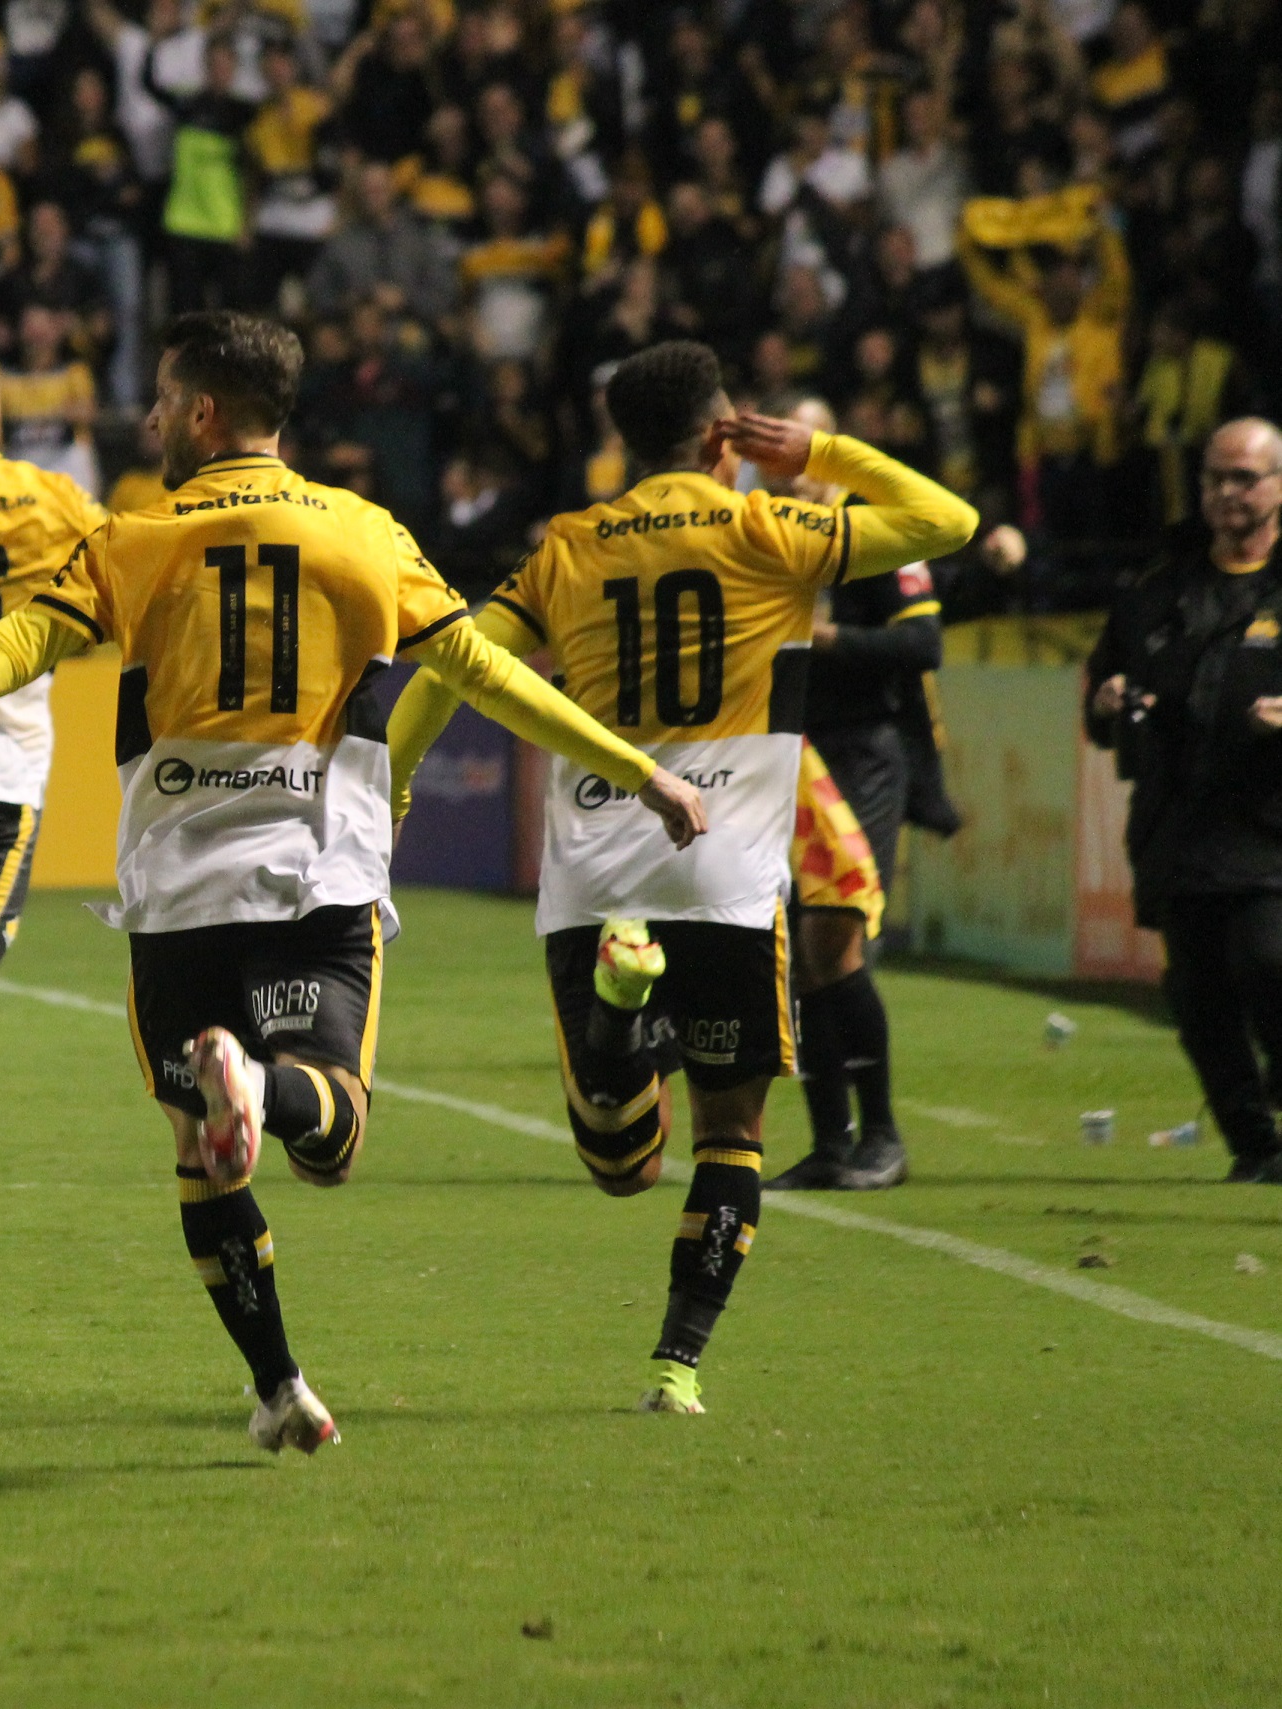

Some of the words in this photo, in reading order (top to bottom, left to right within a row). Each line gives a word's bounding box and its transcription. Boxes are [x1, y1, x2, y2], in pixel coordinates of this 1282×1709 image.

[175, 491, 327, 515] betfast.io
[597, 509, 733, 539] betfast.io
[205, 544, 300, 714] 11
[603, 569, 724, 727] 10
[252, 979, 320, 1025] DUGAS
